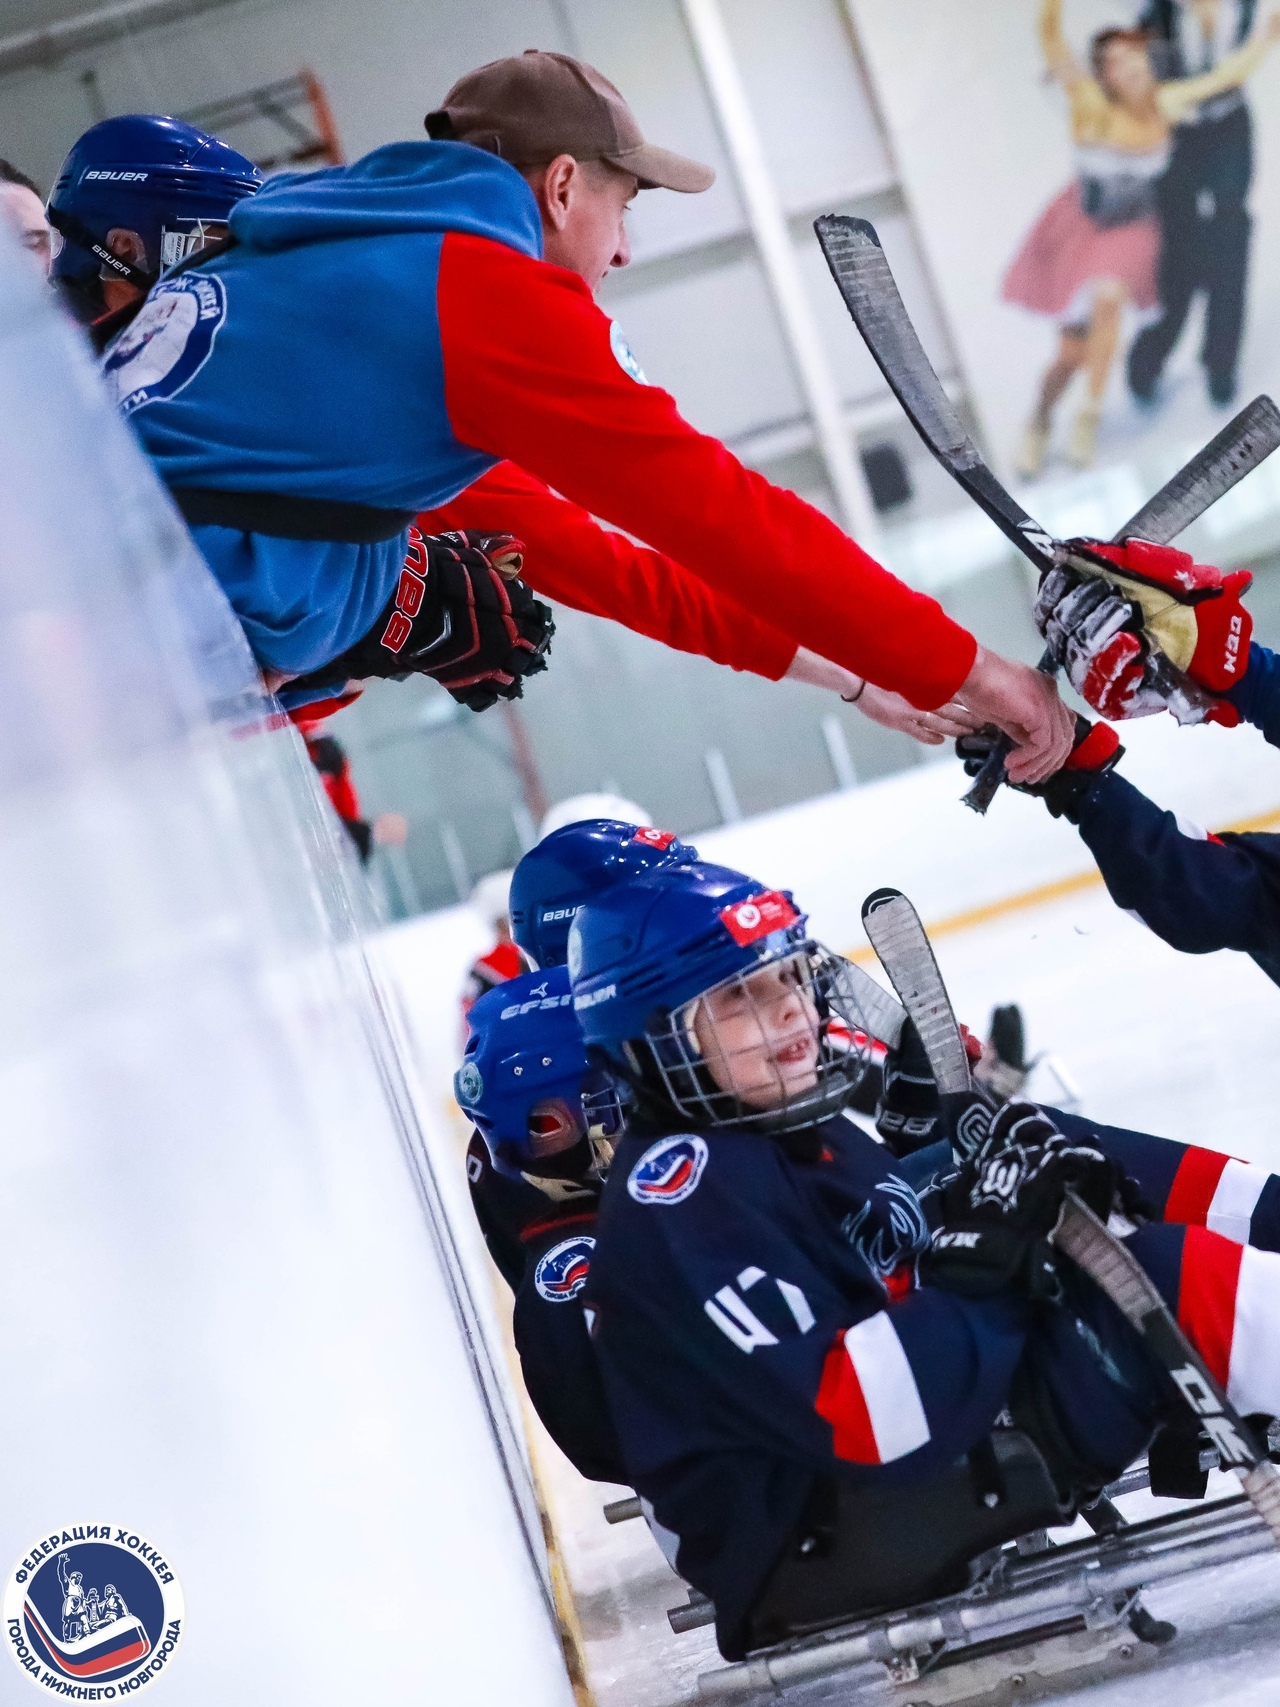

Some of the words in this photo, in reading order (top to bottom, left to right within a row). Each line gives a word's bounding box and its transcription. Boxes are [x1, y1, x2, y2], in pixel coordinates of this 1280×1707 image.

[84, 170, 149, 182] BAUER
[91, 244, 132, 276] BAUER
[380, 526, 429, 654] BAU
